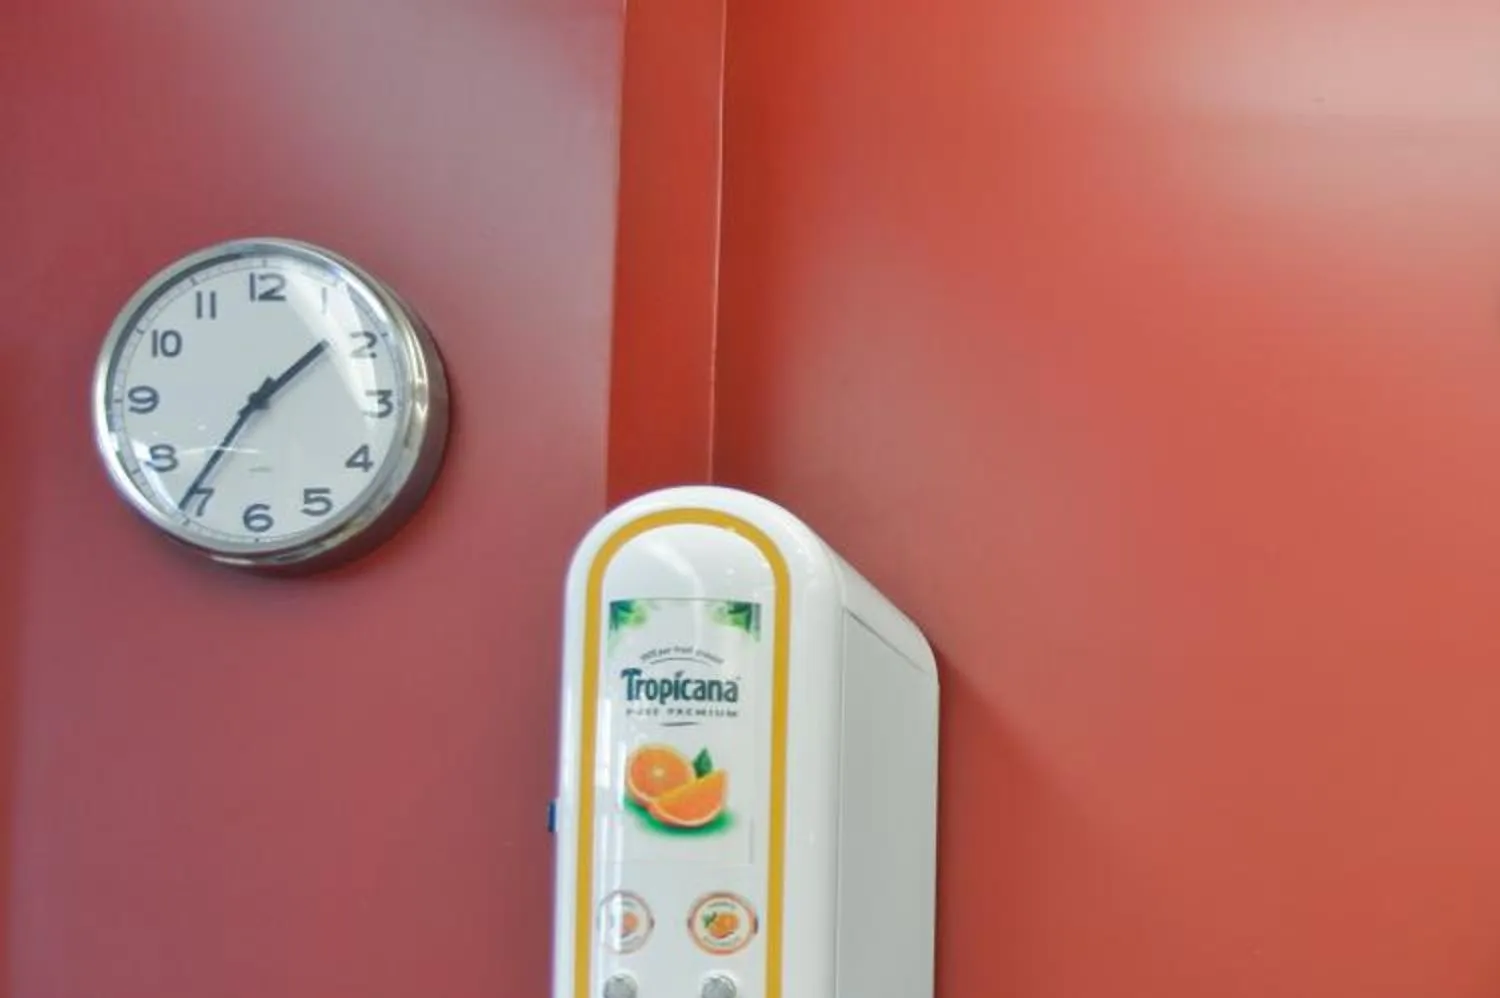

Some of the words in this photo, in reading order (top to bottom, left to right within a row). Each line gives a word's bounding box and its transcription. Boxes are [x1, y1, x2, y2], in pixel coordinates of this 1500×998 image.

[249, 272, 287, 302] 12
[196, 291, 217, 319] 11
[151, 329, 183, 358] 10
[350, 331, 378, 359] 2
[127, 386, 160, 414] 9
[365, 389, 394, 418] 3
[146, 445, 178, 472] 8
[345, 445, 374, 472] 4
[189, 487, 215, 517] 7
[302, 487, 334, 517] 5
[242, 503, 275, 532] 6
[620, 667, 739, 706] Tropicana
